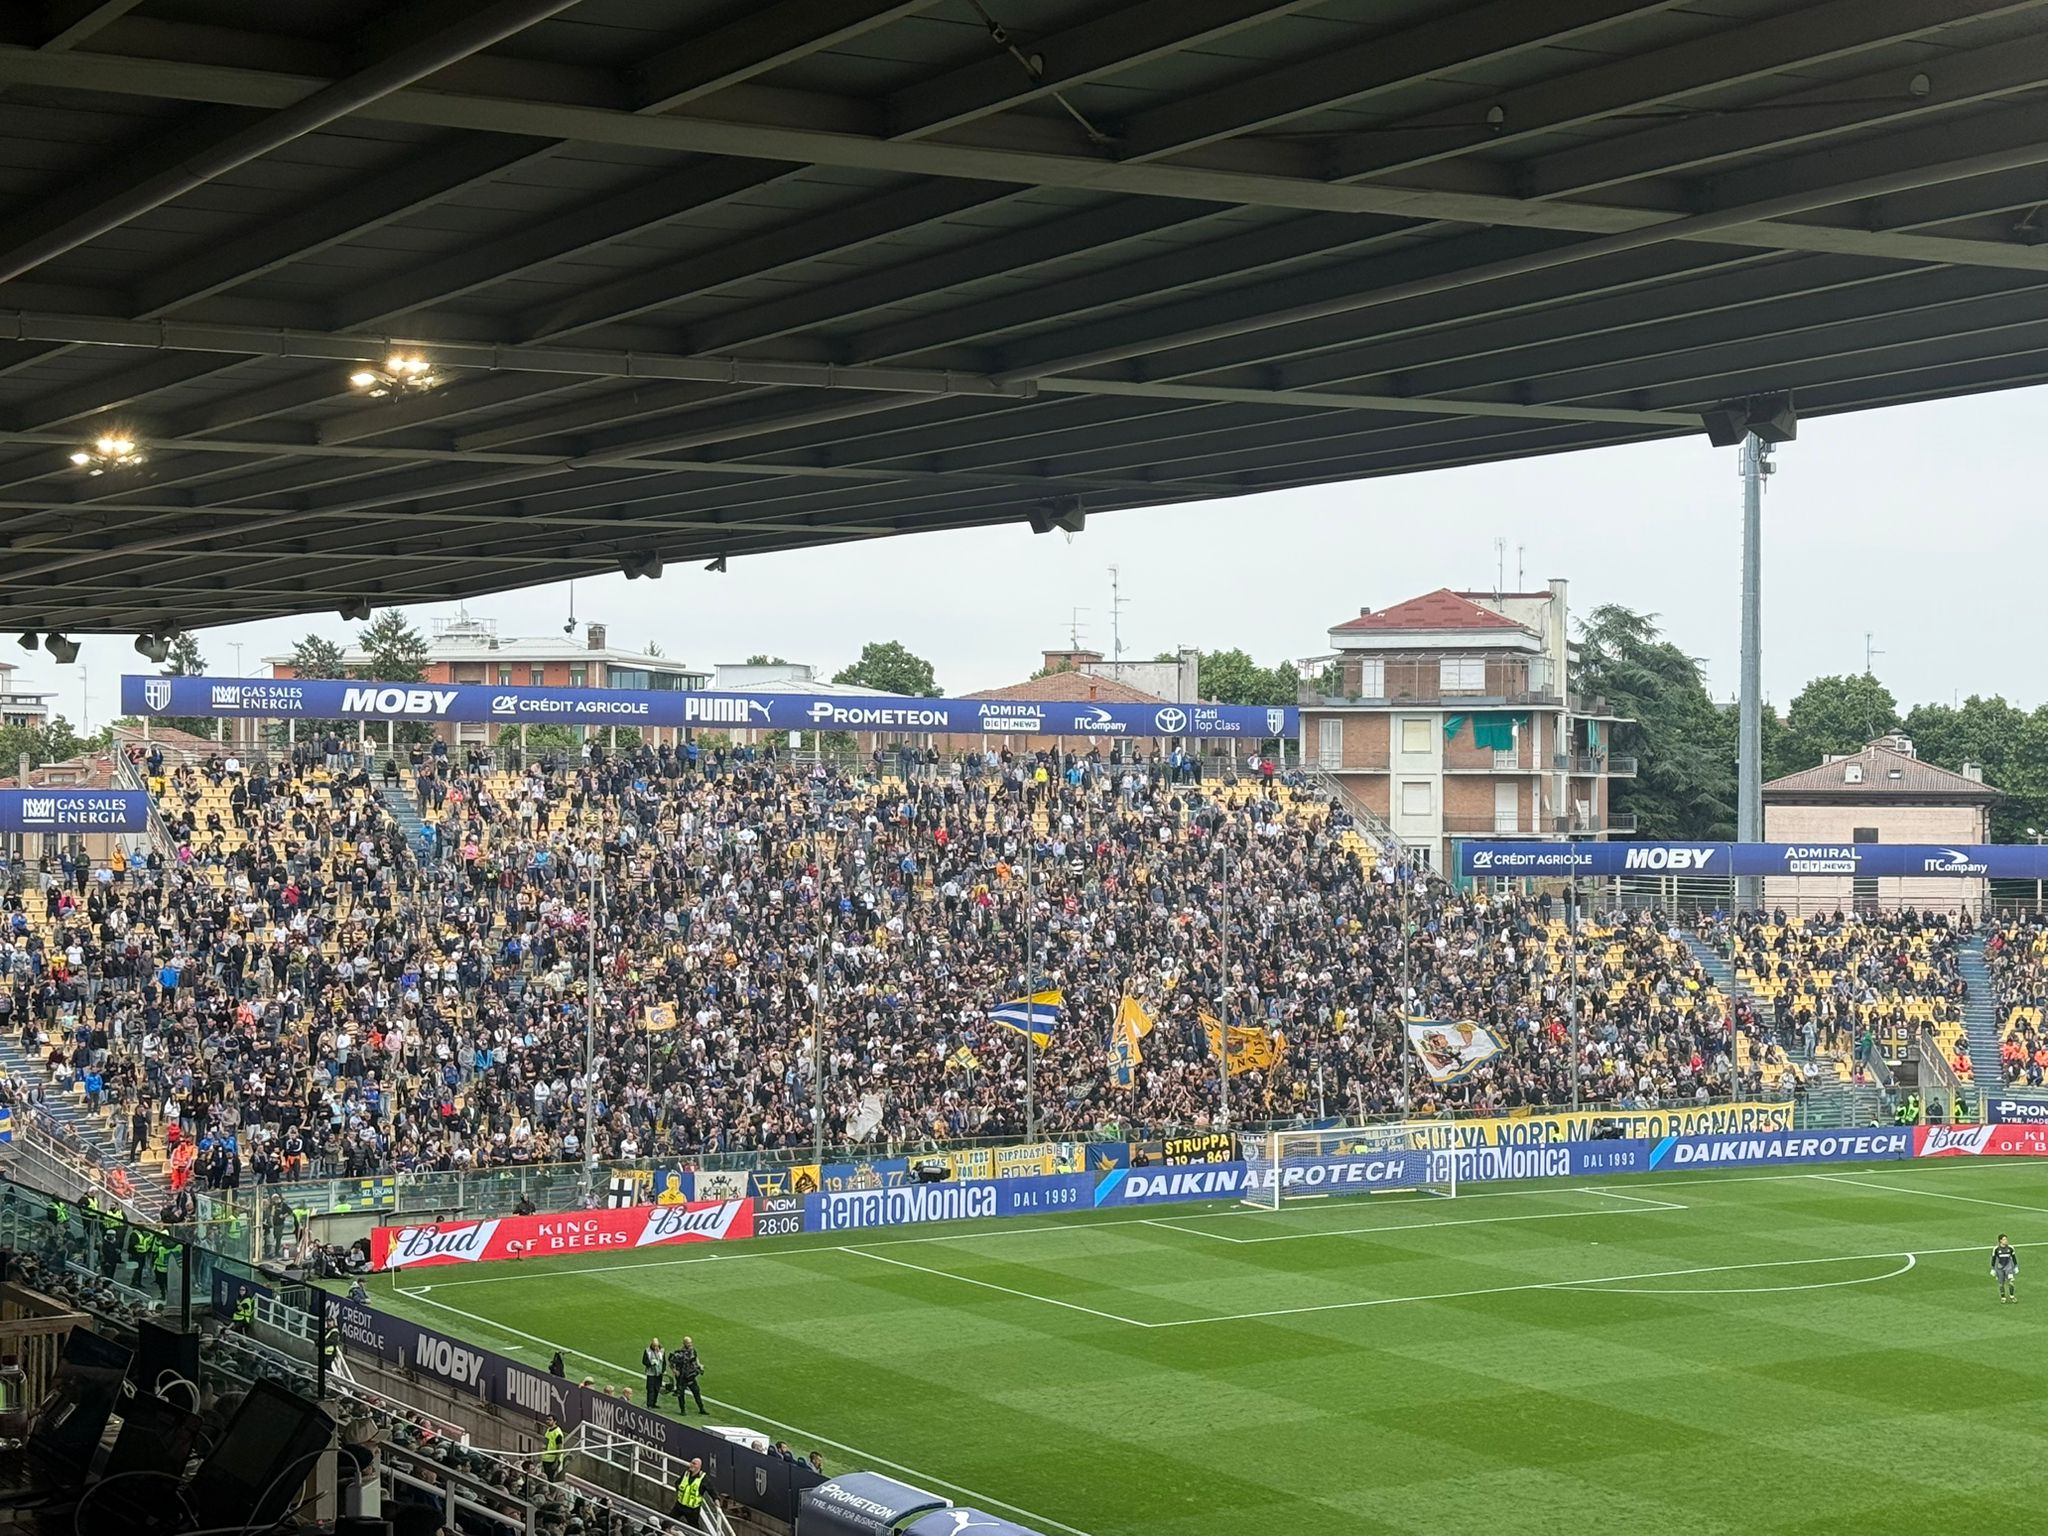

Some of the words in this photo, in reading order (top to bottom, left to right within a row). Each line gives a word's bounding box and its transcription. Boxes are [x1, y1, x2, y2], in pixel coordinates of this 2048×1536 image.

[241, 686, 266, 698] GAS
[269, 686, 303, 699] SALES
[341, 688, 459, 714] MOBY
[243, 699, 303, 710] ENERGIA
[520, 698, 574, 712] CRÉDIT
[576, 701, 649, 715] AGRICOLE
[685, 697, 752, 723] PUMA
[806, 702, 948, 726] PROMETEON
[978, 703, 1046, 717] ADMIRAL
[1195, 708, 1218, 719] Zatti
[1195, 719, 1212, 732] Top
[1214, 720, 1241, 731] Class
[56, 799, 85, 811] GAS
[88, 799, 127, 811] SALES
[58, 812, 127, 823] ENERGIA
[1494, 852, 1537, 865] CRÉDIT
[1537, 854, 1593, 866] AGRICOLE
[1625, 848, 1716, 870] MOBY
[1784, 847, 1862, 860] ADMIRAL
[1924, 858, 1988, 875] ITCompany
[1165, 1134, 1229, 1155] STRUPPA
[1928, 1124, 1983, 1148] Bud
[2000, 1141, 2024, 1151] OF
[1175, 1155, 1188, 1165] 19
[1207, 1150, 1223, 1164] 86
[1674, 1140, 1767, 1164] DAIKIN
[1767, 1134, 1907, 1159] AEROTECH
[1583, 1153, 1604, 1168] DAL
[1608, 1151, 1635, 1167] 1993
[1124, 1170, 1240, 1198] DAIKIN
[1240, 1160, 1406, 1189] AEROTECH
[1013, 1191, 1039, 1207] DAL
[1045, 1187, 1077, 1205] 1993
[648, 1199, 729, 1235] Bud
[758, 1216, 800, 1236] 28:06
[538, 1219, 599, 1236] KING
[397, 1219, 485, 1257] Bud
[506, 1239, 535, 1254] OF
[550, 1231, 628, 1249] BEERS
[341, 1306, 372, 1329] CRÉDIT
[341, 1323, 385, 1350] AGRICOLE
[416, 1333, 484, 1388] MOBY
[506, 1366, 551, 1416] PUMA
[615, 1406, 636, 1430] GAS
[638, 1414, 666, 1443] SALES
[820, 1483, 897, 1519] PROMETEON
